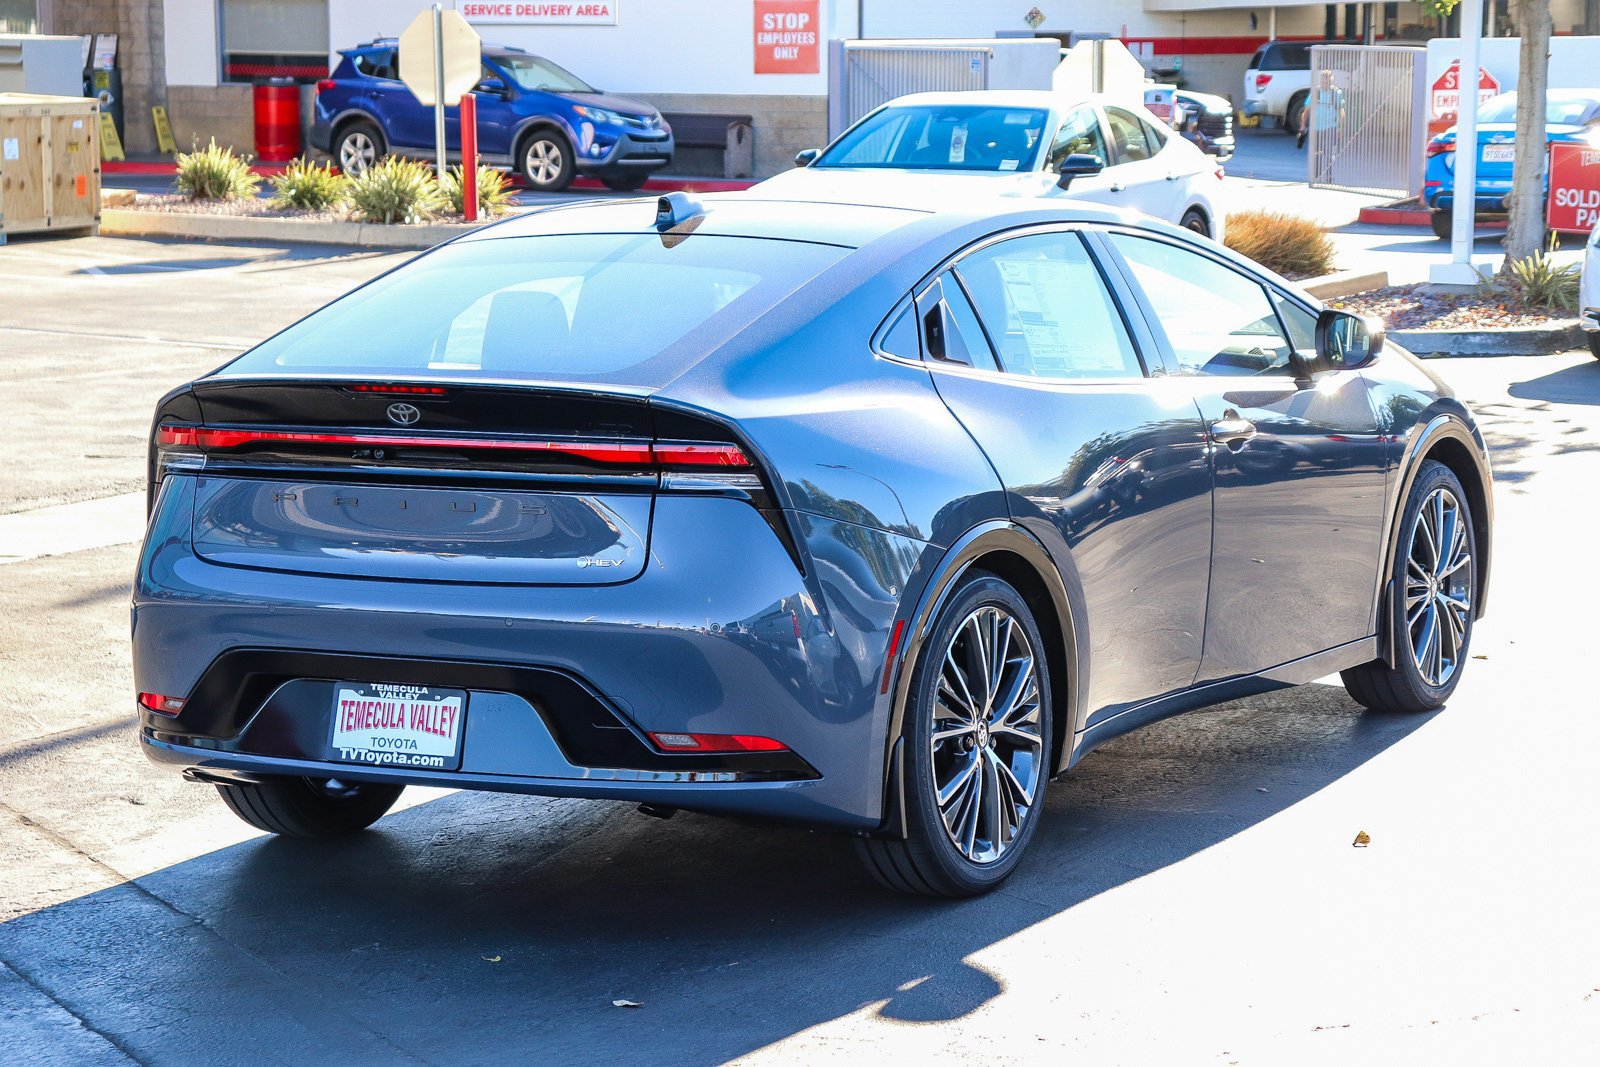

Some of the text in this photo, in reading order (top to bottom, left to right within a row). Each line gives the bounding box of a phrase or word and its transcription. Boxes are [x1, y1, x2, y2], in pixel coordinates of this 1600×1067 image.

[464, 4, 609, 16] SERVICE DELIVERY AREA
[763, 13, 810, 29] STOP
[758, 31, 816, 44] EMPLOYEES
[774, 46, 799, 59] ONLY
[1555, 187, 1600, 209] SOLD
[273, 492, 546, 515] PRIUS
[588, 559, 624, 567] HEV
[370, 683, 428, 694] TEMECULA
[379, 691, 420, 700] VALLEY
[340, 700, 457, 738] TEMECULA VALLEY
[371, 737, 418, 750] TOYOTA
[340, 747, 444, 767] TVToyota.com
